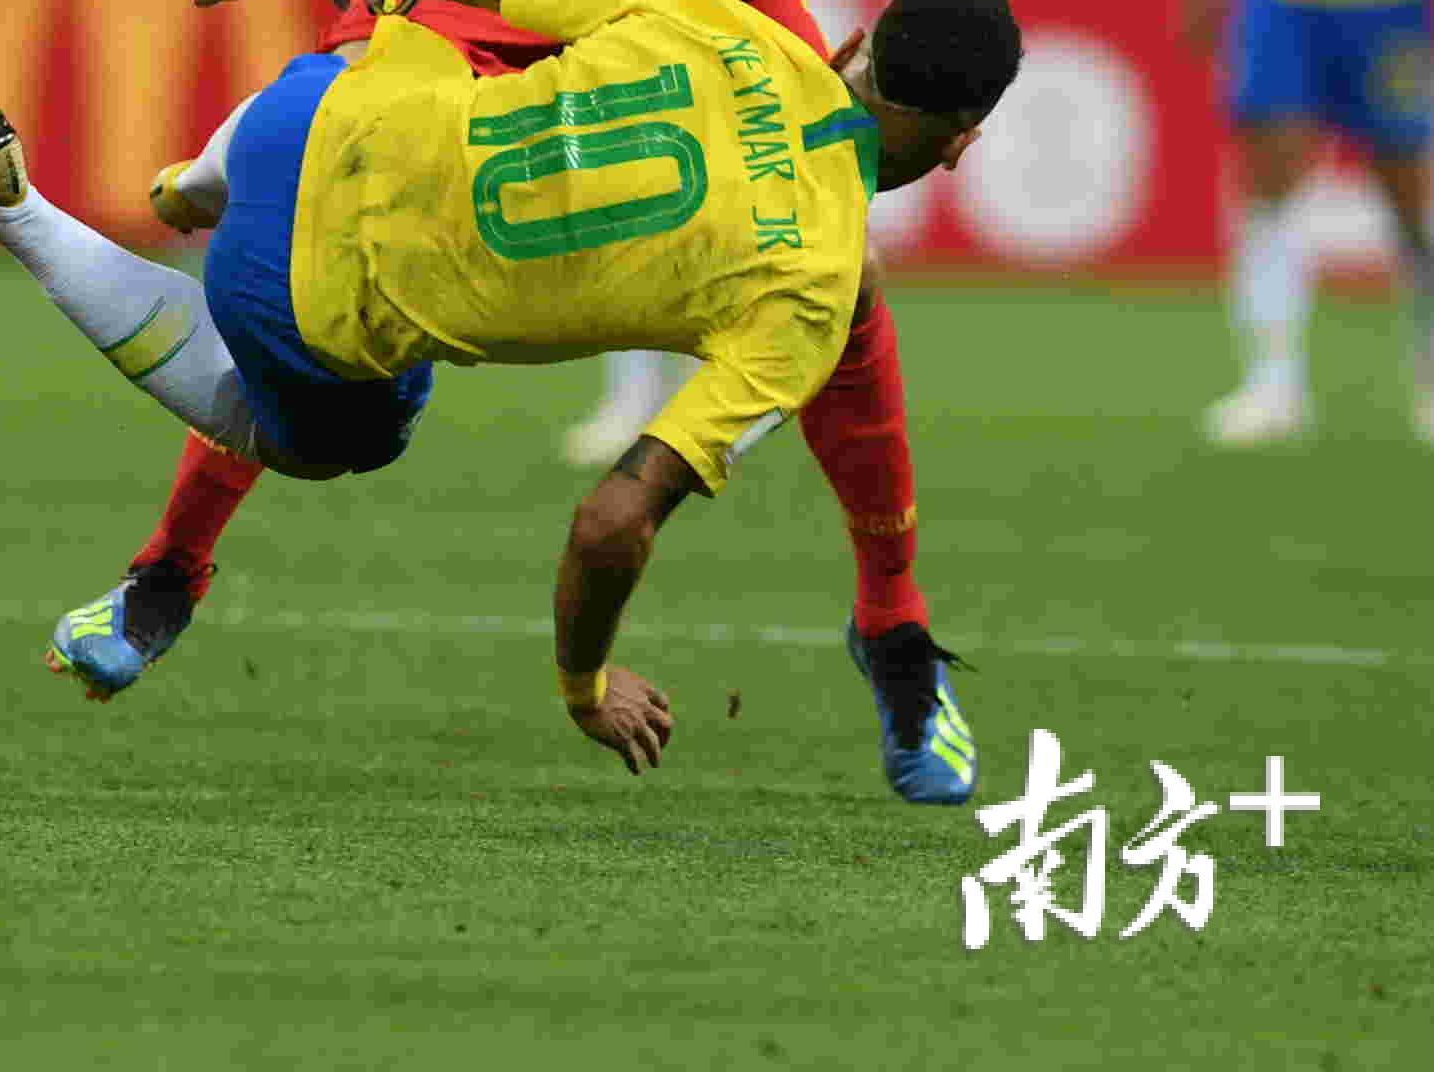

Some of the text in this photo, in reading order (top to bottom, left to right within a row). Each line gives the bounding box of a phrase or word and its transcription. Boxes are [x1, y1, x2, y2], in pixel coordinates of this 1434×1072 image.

[468, 62, 709, 262] 10
[711, 34, 803, 252] NEYMAR JR
